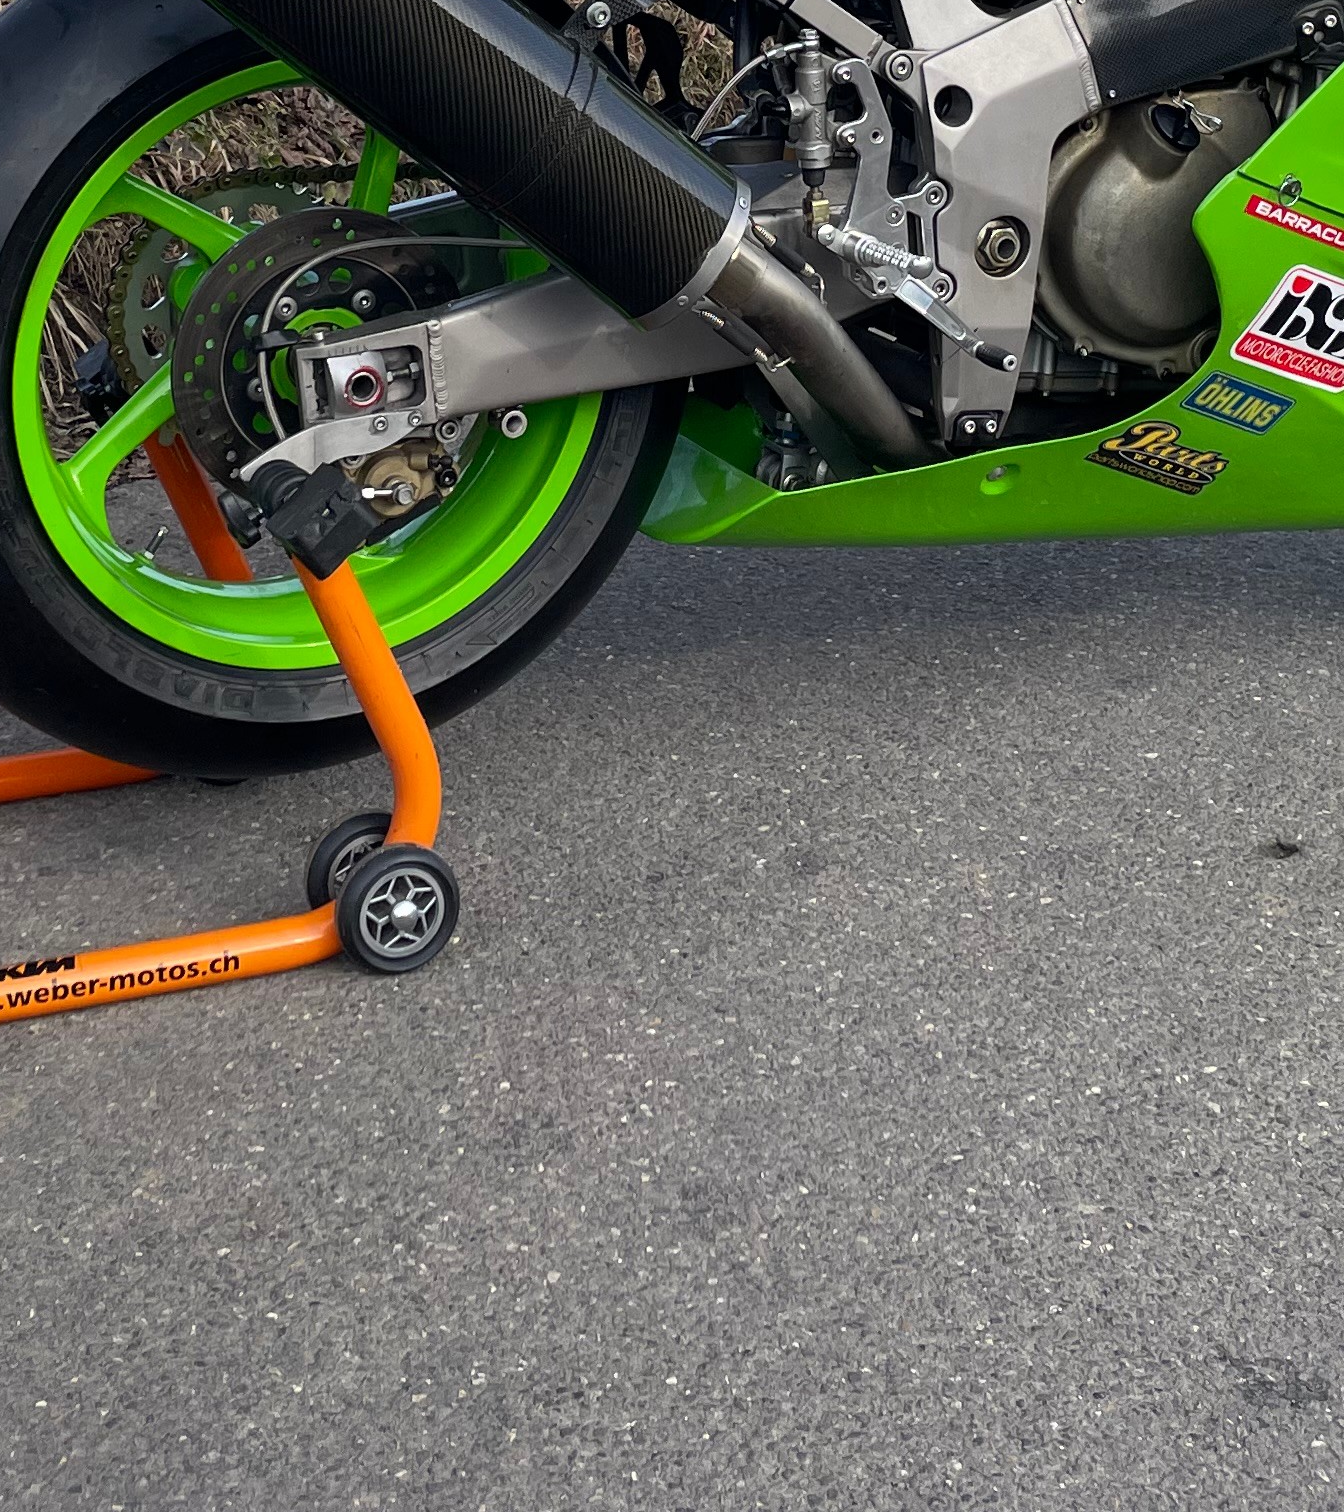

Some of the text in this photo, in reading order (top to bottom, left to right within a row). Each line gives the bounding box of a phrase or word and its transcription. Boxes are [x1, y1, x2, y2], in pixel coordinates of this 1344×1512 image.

[1194, 375, 1283, 428] ÖHLINS
[1103, 422, 1226, 472] Parts
[1133, 452, 1200, 479] WORLD
